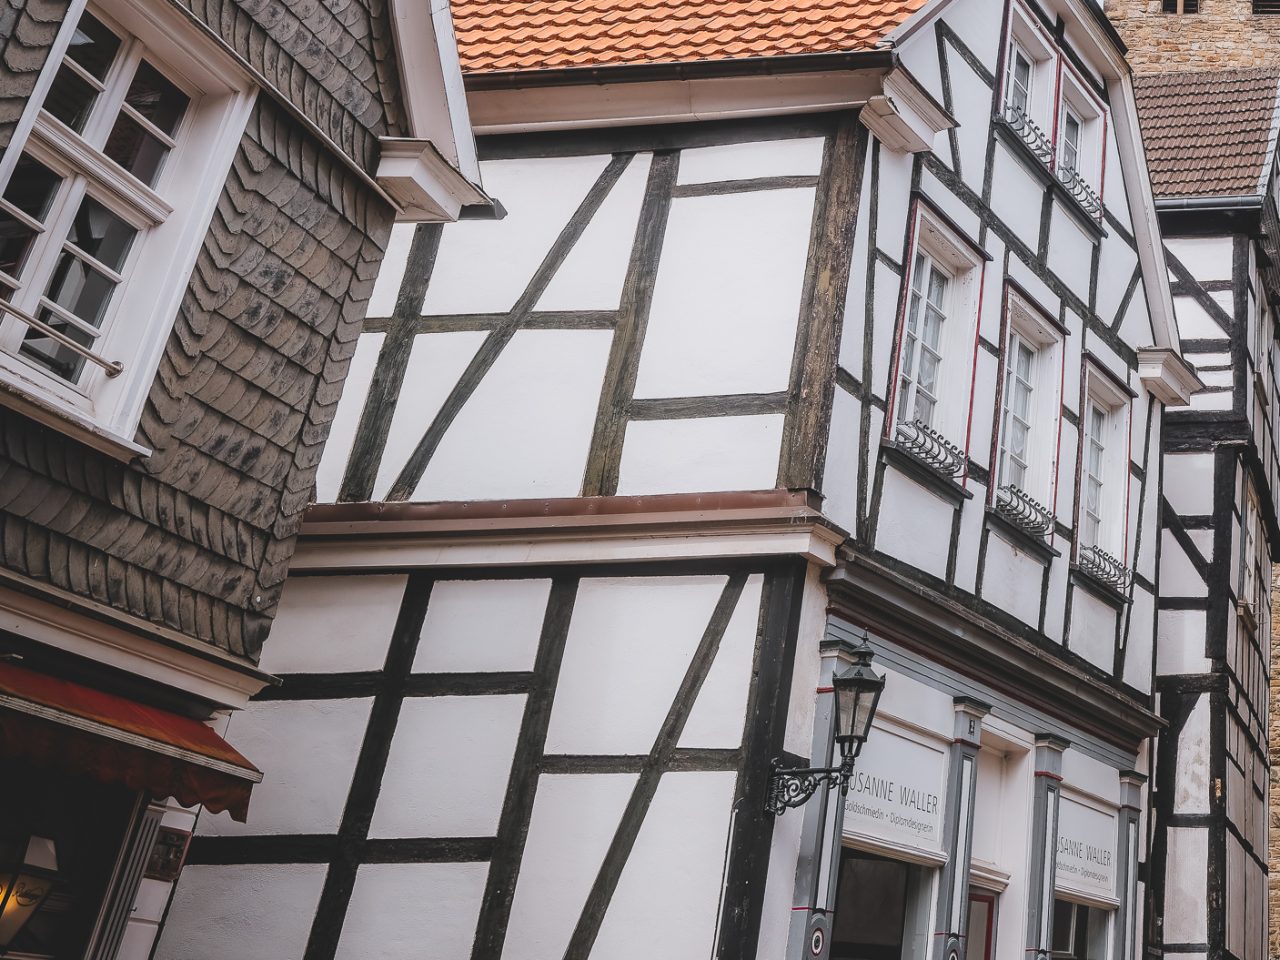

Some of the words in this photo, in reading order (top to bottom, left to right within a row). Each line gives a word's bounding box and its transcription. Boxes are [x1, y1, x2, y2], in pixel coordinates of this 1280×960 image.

[848, 771, 894, 802] USANNE
[899, 785, 938, 815] WALLER
[1086, 844, 1111, 867] WALLER
